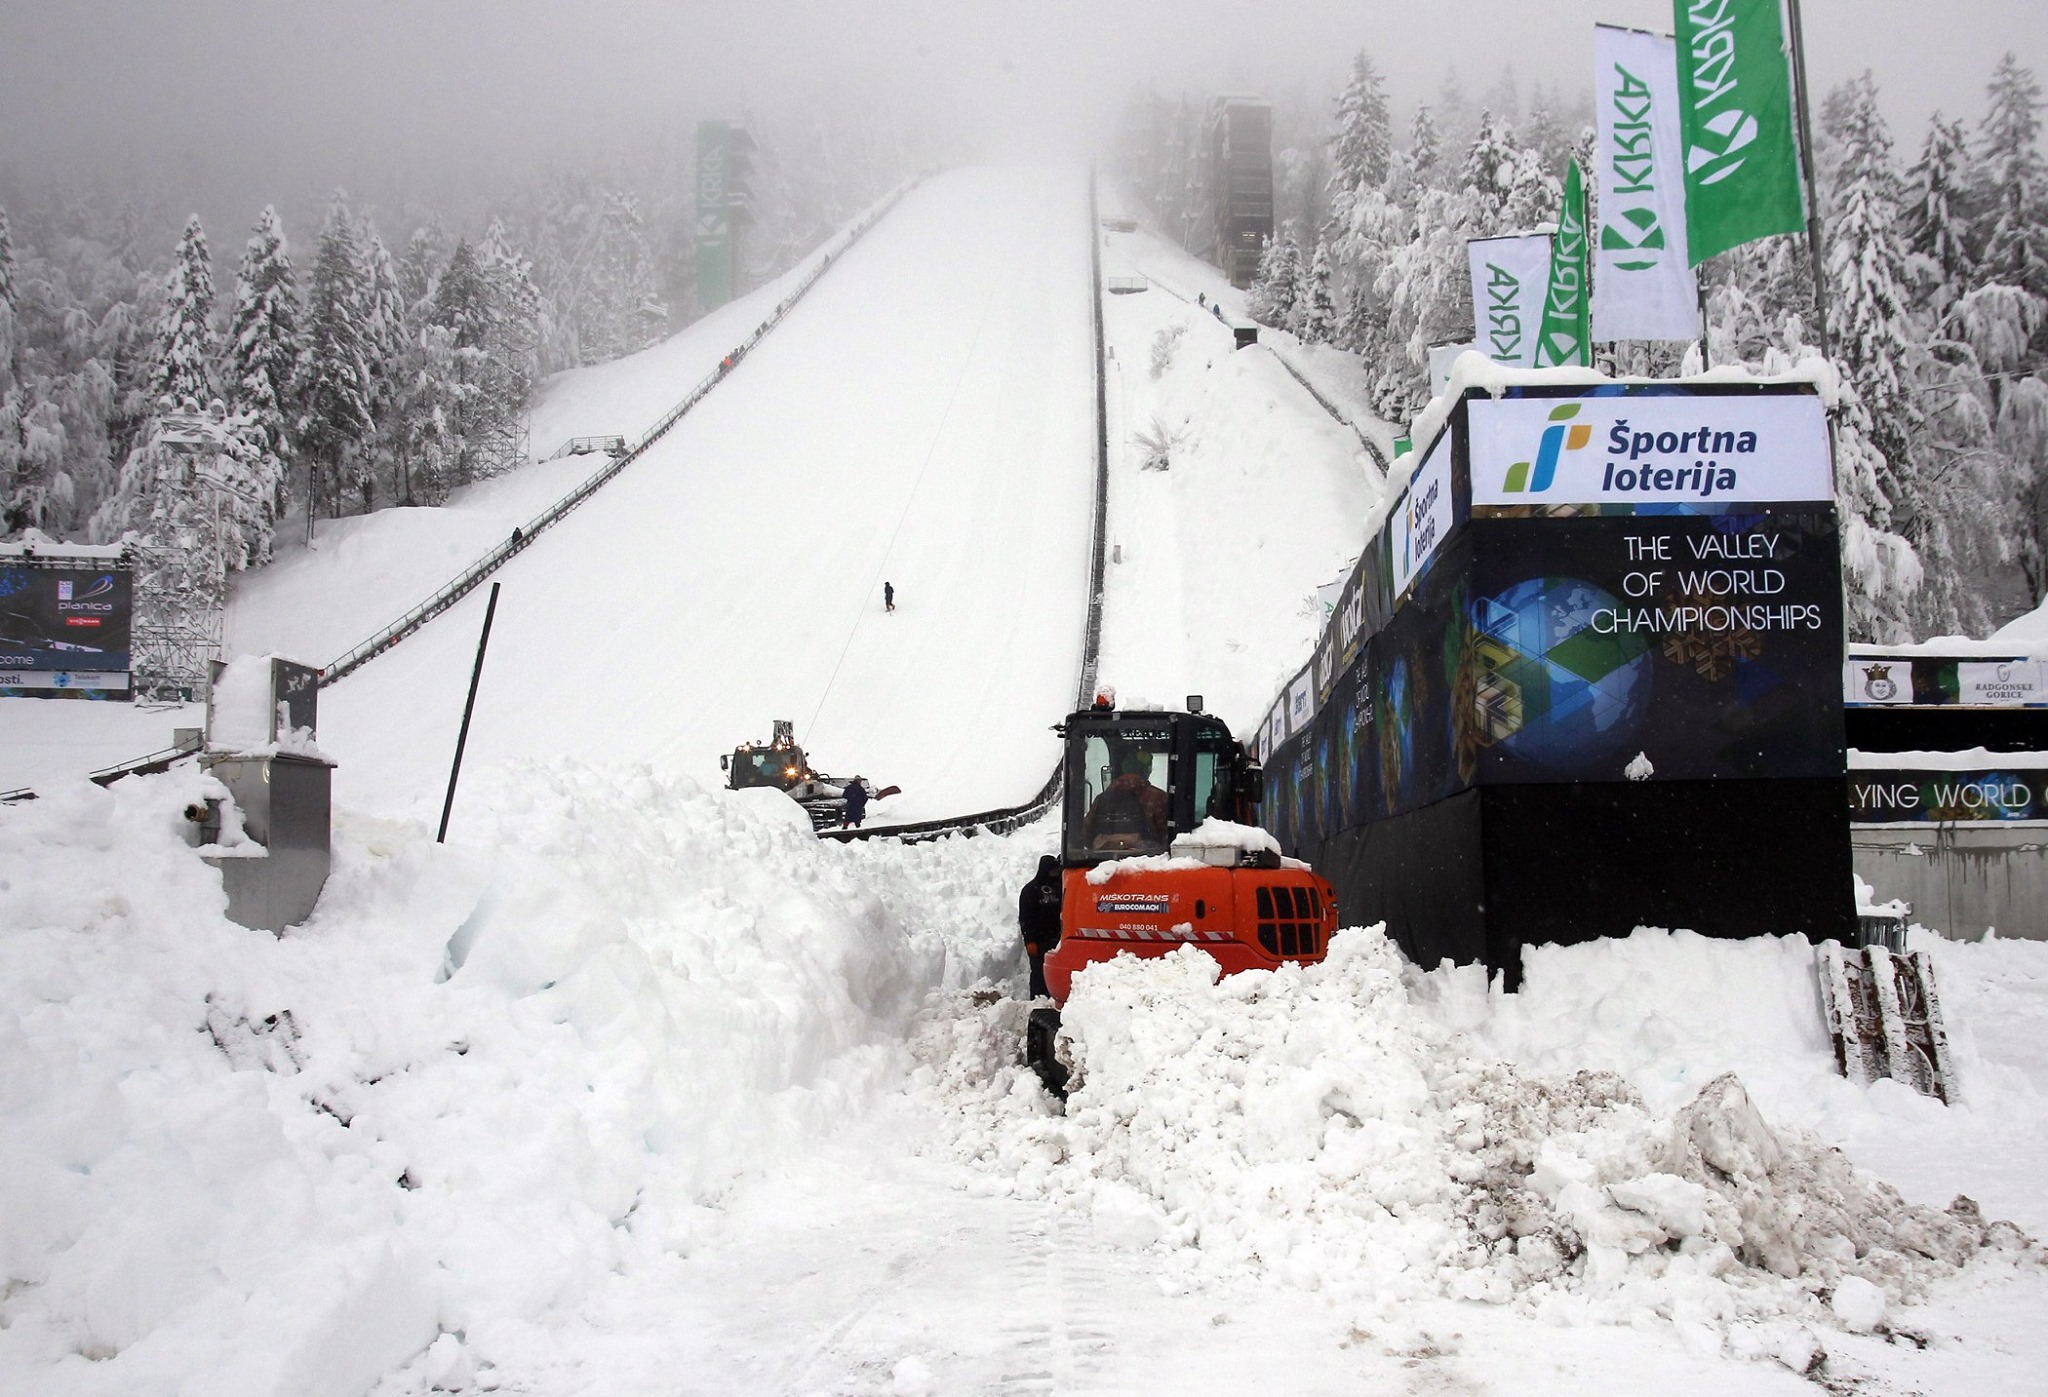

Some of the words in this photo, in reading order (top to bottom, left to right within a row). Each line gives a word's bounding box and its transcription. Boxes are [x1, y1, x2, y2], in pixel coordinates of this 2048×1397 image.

[1607, 419, 1758, 460] Športna
[1601, 461, 1738, 496] loterija
[1624, 535, 1673, 561] THE
[1686, 534, 1780, 560] VALLEY
[1623, 571, 1662, 597] OF
[1677, 569, 1786, 596] WORLD
[58, 602, 113, 611] planica
[1590, 604, 1822, 635] CHAMPIONSHIPS
[1975, 683, 2035, 691] RADGONSKE
[1986, 691, 2023, 699] GORICE
[1849, 783, 1920, 808] YING
[1933, 783, 2032, 808] WORLD
